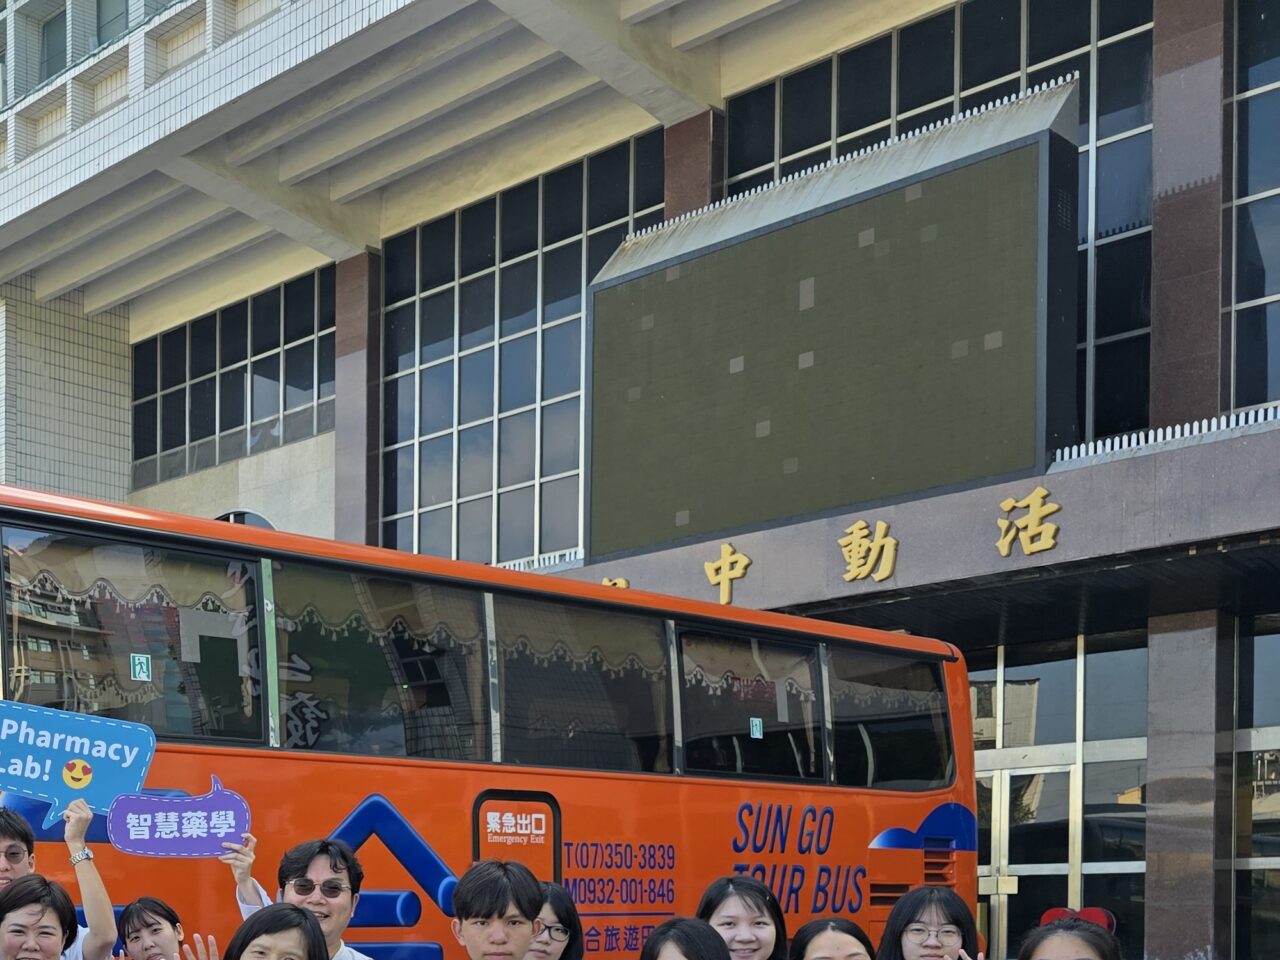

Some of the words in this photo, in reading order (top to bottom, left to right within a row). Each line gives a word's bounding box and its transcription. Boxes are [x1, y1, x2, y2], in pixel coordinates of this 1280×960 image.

[0, 720, 139, 768] Pharmacy
[125, 811, 236, 840] 智慧藥學
[487, 812, 545, 834] 緊急出口
[732, 801, 792, 853] SUN
[798, 805, 834, 855] GO
[488, 834, 528, 845] Emergency
[531, 835, 544, 843] Exit
[564, 843, 675, 870] T(07)350-3839
[564, 878, 675, 904] M0932-001-846
[812, 864, 867, 913] BUS
